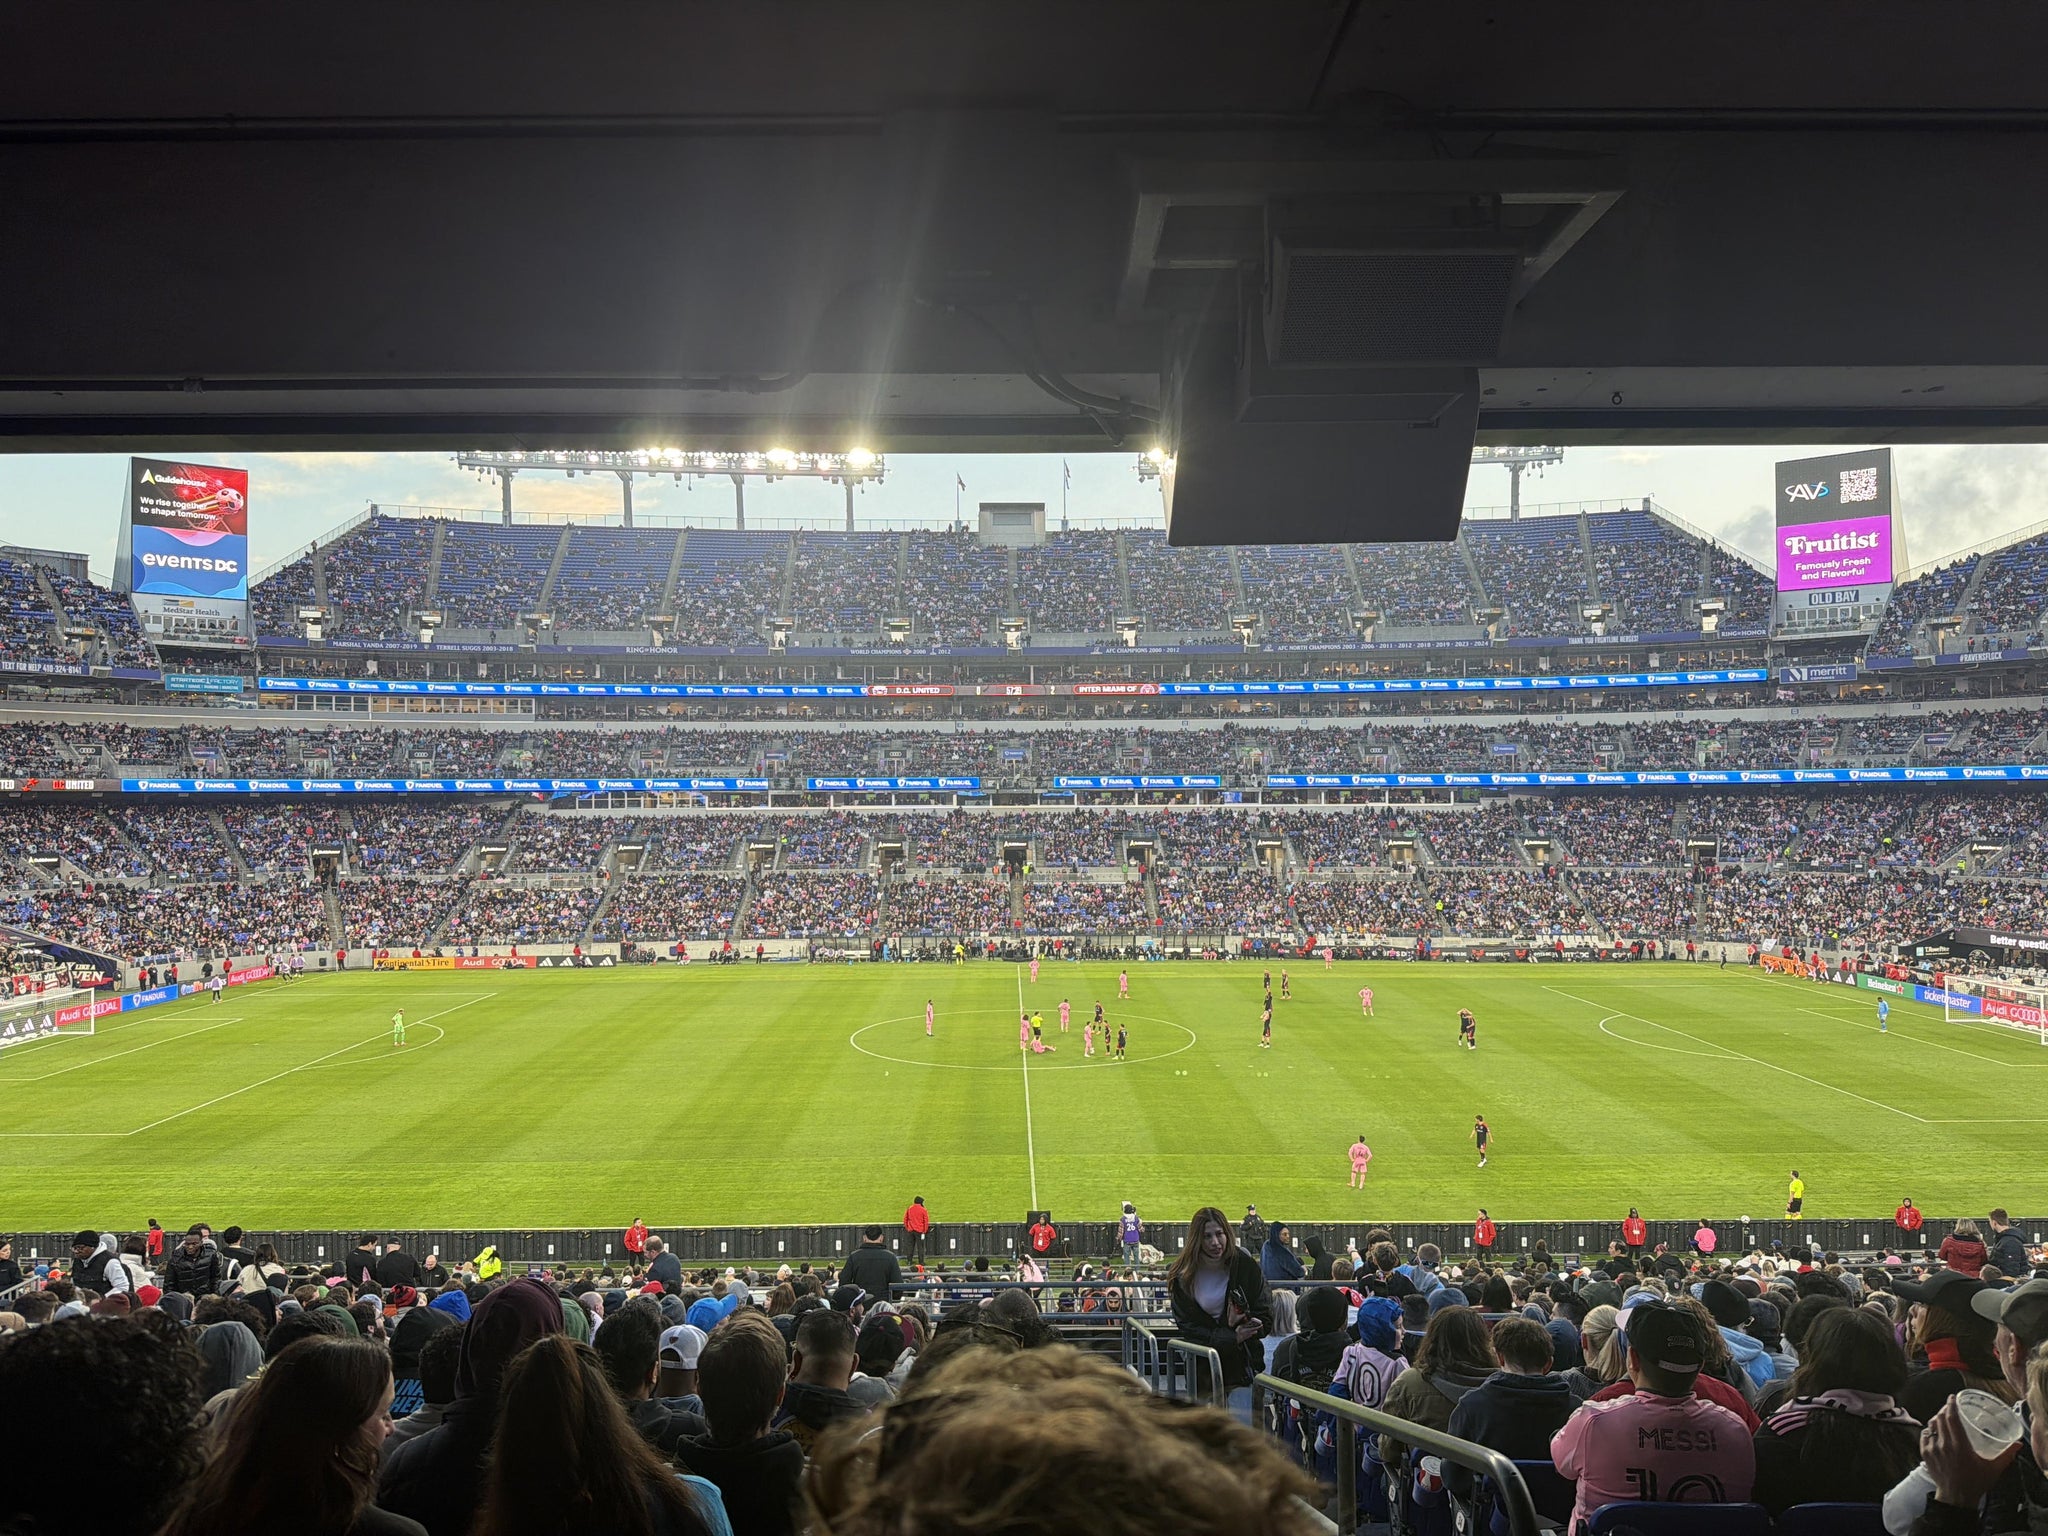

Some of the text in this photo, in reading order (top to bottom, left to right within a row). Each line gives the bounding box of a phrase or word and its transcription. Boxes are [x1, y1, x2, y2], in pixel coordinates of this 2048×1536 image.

[154, 475, 206, 487] Guidehouse
[140, 496, 207, 510] We rise together
[151, 507, 176, 517] shape
[177, 509, 218, 520] tomorrow.
[1785, 531, 1879, 555] Fruitist
[1796, 557, 1871, 572] Famously Fresh
[1801, 568, 1865, 580] and Flavorful
[1811, 590, 1857, 605] OLD BAY
[163, 606, 220, 616] MedStar Health
[1568, 636, 1583, 644] THANK
[1584, 636, 1593, 644] YOU
[1595, 635, 1618, 643] FRONTLINE
[1959, 650, 2003, 663] #RAVENSFLOCK
[2, 661, 16, 670] TEXT
[16, 662, 27, 671] FOR
[28, 663, 42, 672] HELP
[1810, 666, 1847, 677] merritt
[1050, 686, 1055, 695] 2
[53, 780, 94, 790] DC UNITED
[1990, 934, 2017, 946] Better
[432, 958, 450, 967] Tire
[204, 978, 227, 990] FITSS
[231, 973, 245, 983] Audi
[1867, 978, 1897, 993] Heineken
[141, 991, 166, 1003] FANDUEL
[1986, 1002, 2008, 1016] Audi
[60, 1009, 81, 1023] Audi
[1127, 1223, 1136, 1231] 26
[1346, 1354, 1381, 1408] 10
[1638, 1426, 1717, 1452] MESSI
